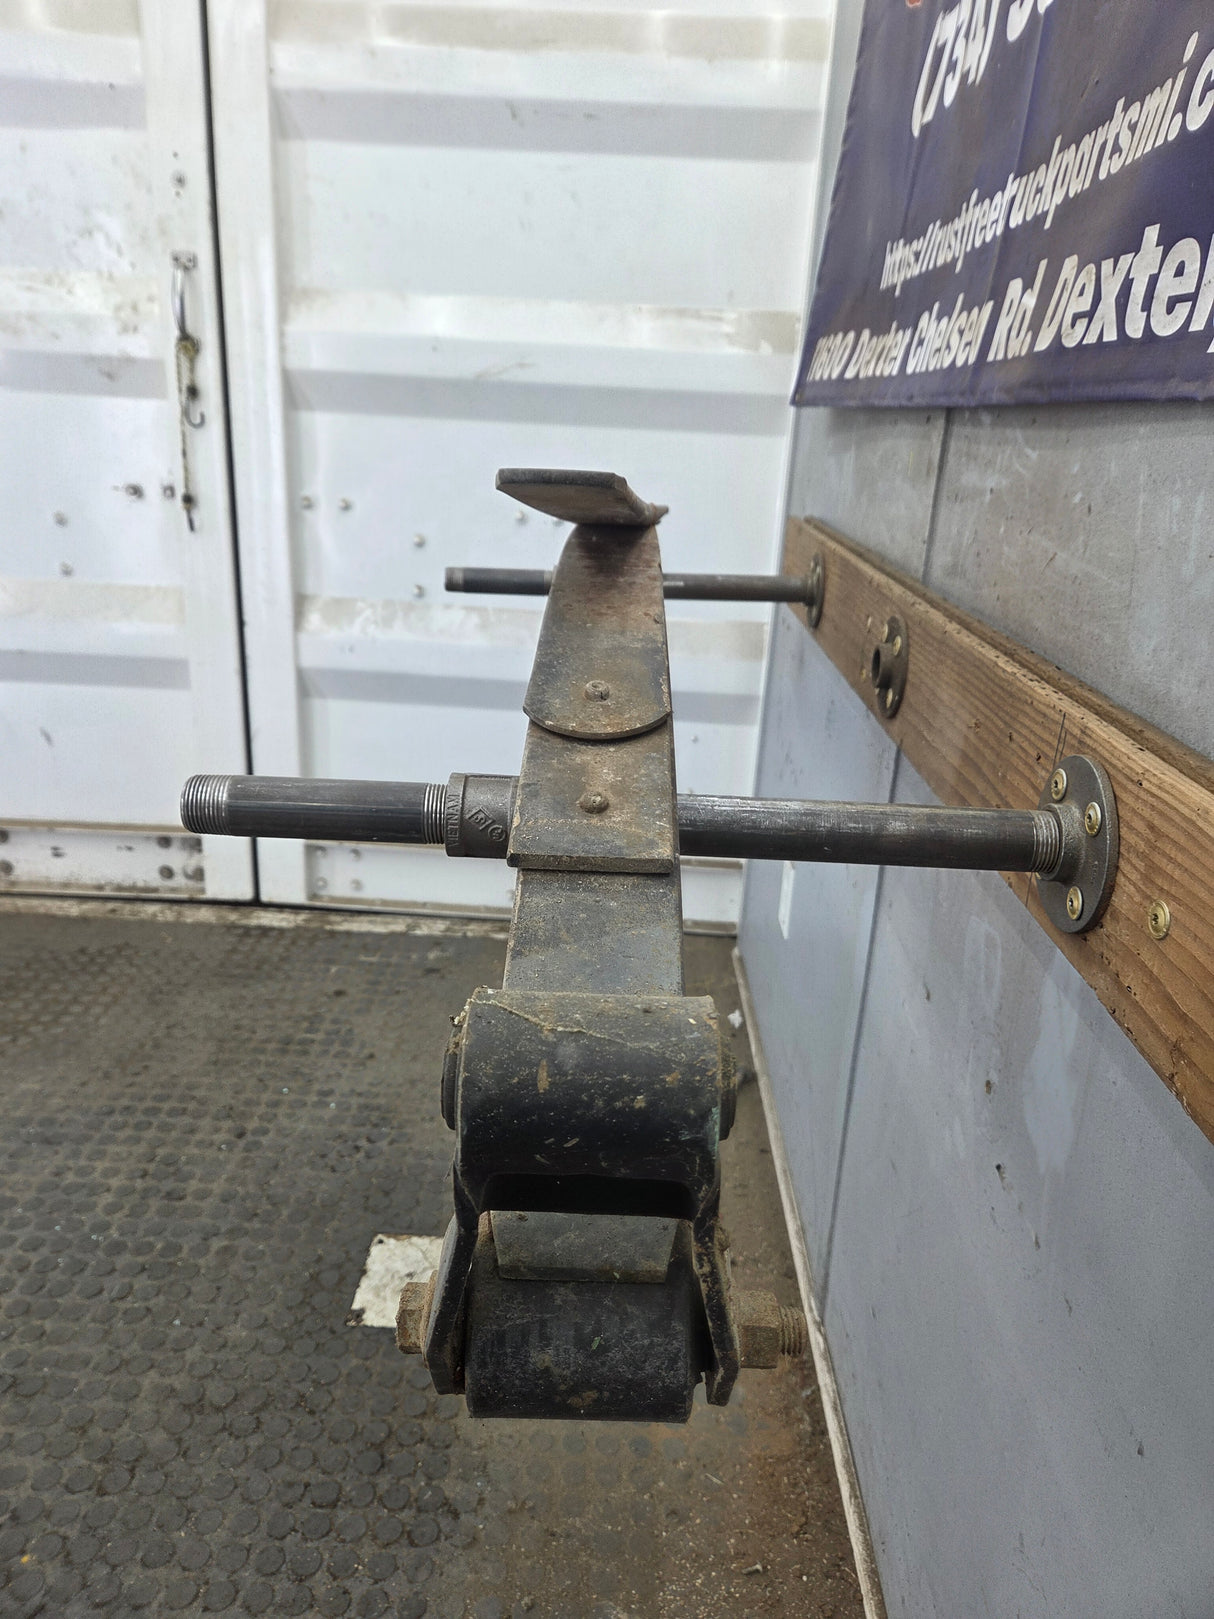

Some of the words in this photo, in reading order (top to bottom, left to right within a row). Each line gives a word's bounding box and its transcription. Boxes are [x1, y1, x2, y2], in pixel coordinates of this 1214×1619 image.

[912, 0, 1000, 138] (734)
[843, 320, 912, 380] Dexter
[905, 292, 994, 376] Chelsea
[987, 258, 1048, 362] Rd.
[446, 794, 461, 847] VIETNAM
